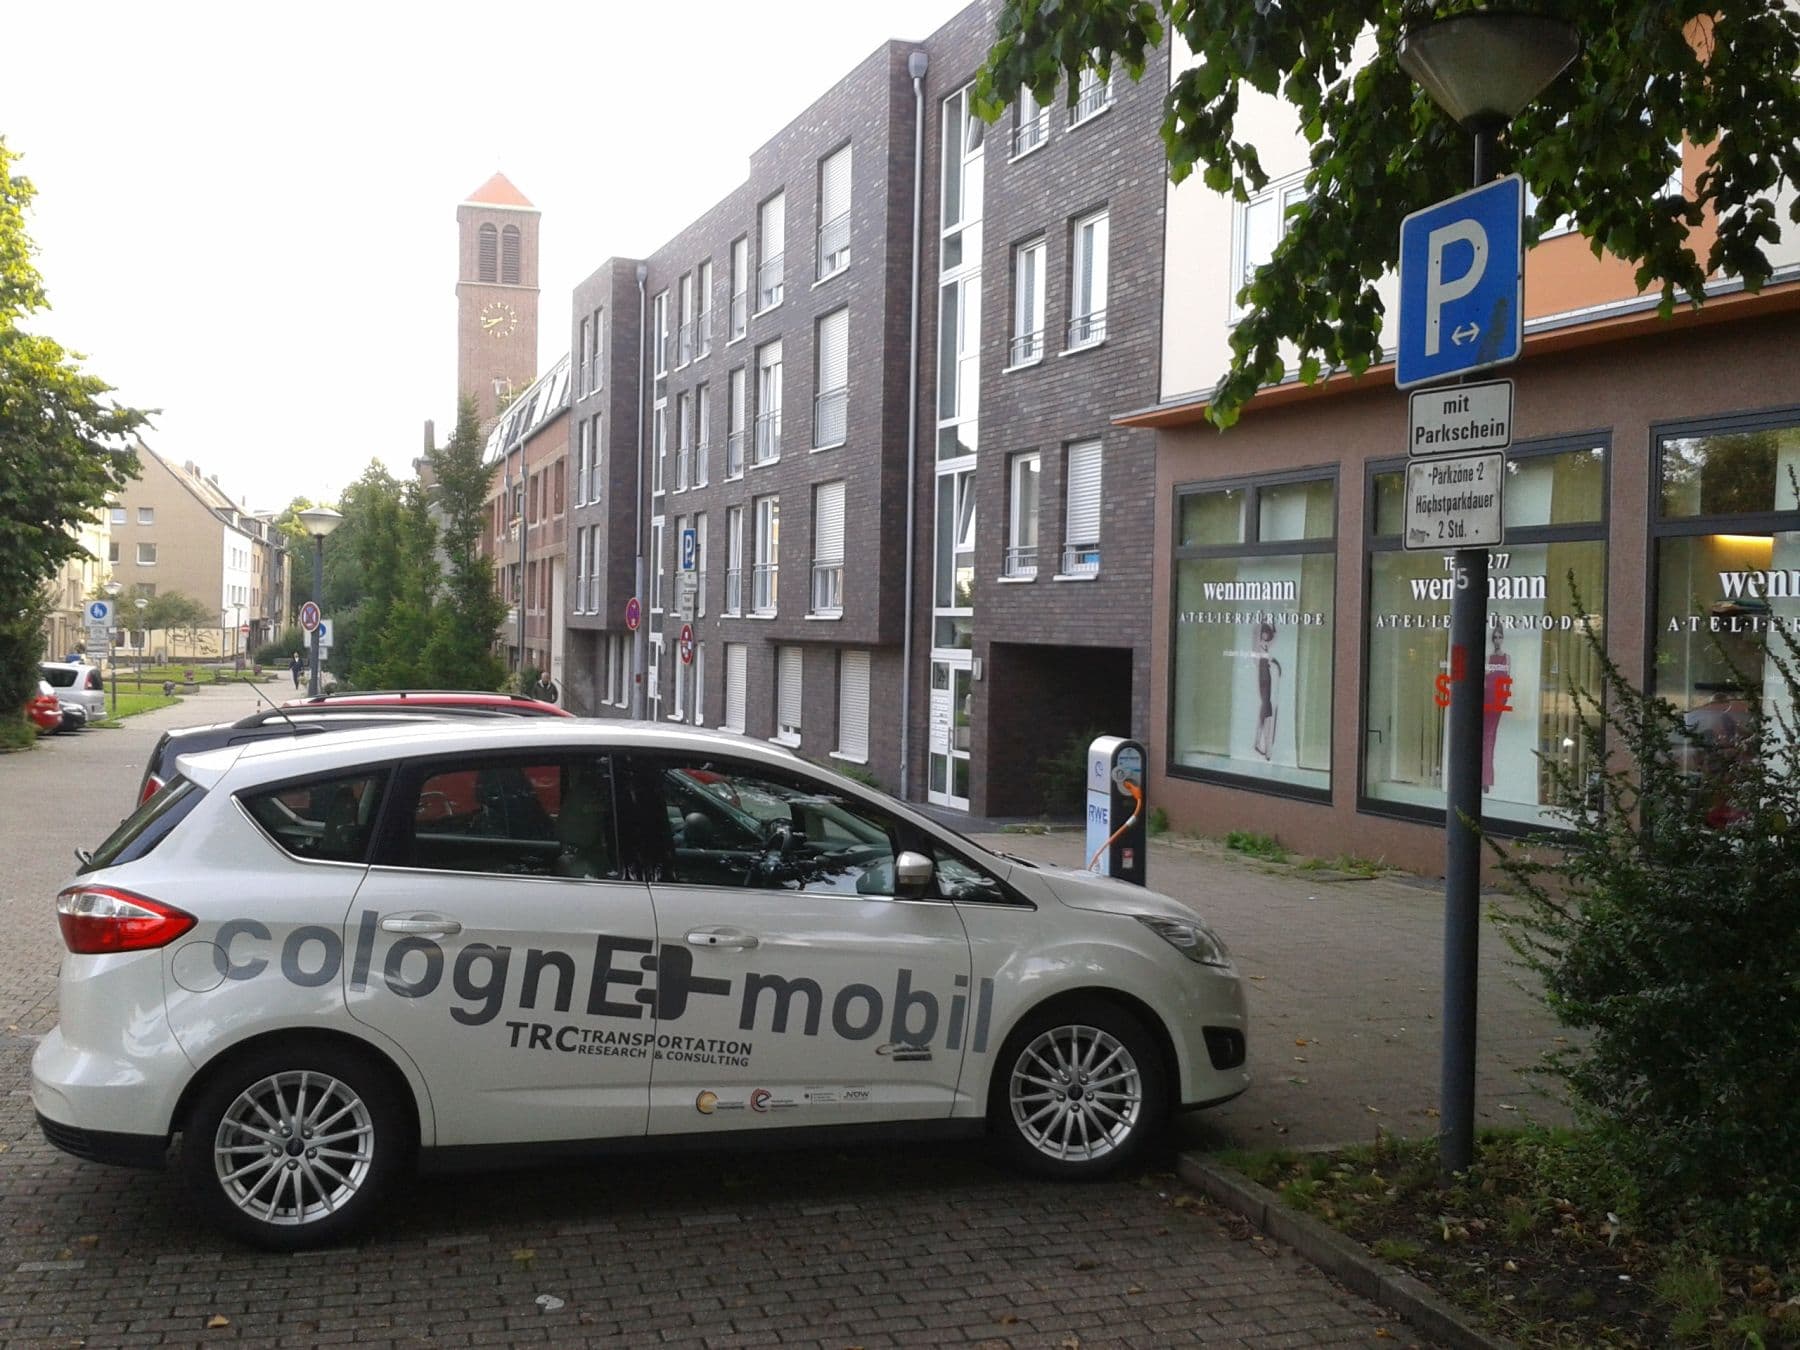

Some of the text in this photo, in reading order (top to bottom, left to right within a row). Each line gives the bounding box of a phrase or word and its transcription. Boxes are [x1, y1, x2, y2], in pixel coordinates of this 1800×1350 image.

[1425, 219, 1489, 356] P
[1443, 394, 1470, 415] mit
[1415, 418, 1505, 445] Parkschein
[1432, 462, 1484, 486] Parkzone 2
[1416, 491, 1494, 515] Höchstparkdauer
[1438, 520, 1467, 539] 2 Std.
[1443, 556, 1456, 571] TE
[1203, 580, 1296, 601] wennmann
[1411, 576, 1547, 601] wenann
[1088, 804, 1108, 825] RWE
[506, 1021, 753, 1055] TRC TRANSPORTATION
[578, 1045, 750, 1067] RESEARCH & CONSULTING
